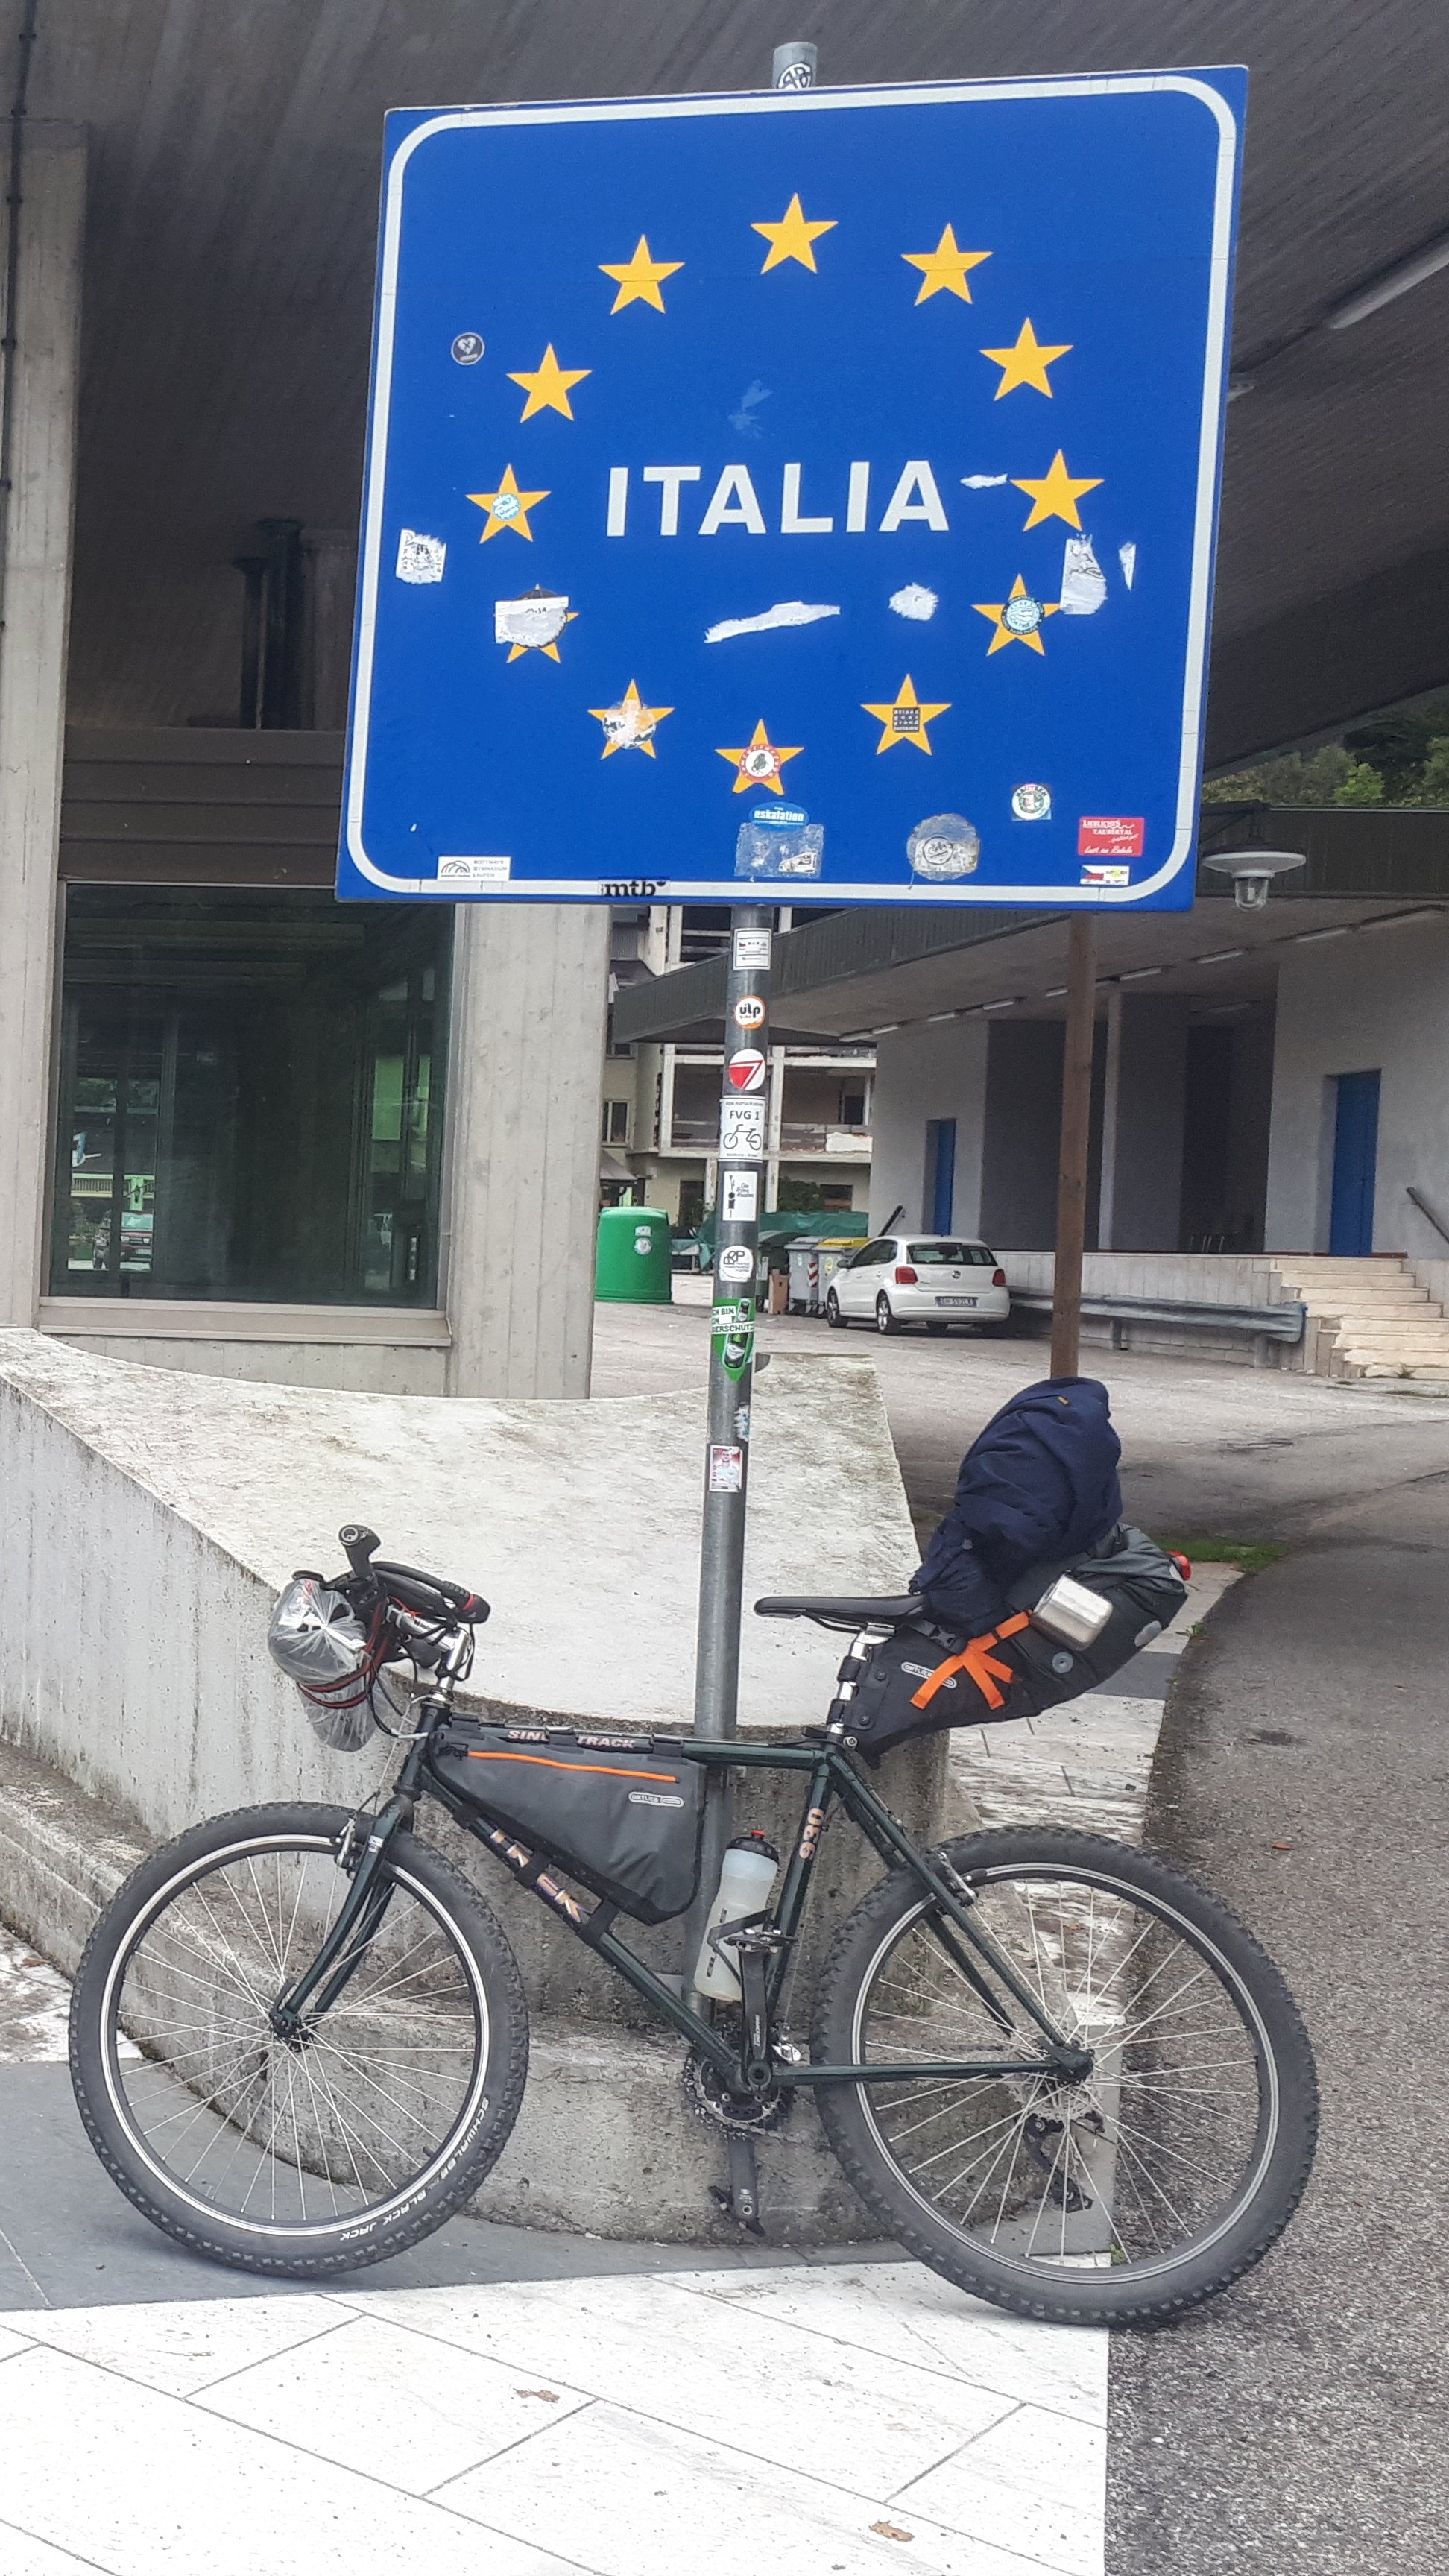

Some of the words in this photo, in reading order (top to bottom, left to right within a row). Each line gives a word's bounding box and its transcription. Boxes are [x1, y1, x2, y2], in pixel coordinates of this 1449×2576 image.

[607, 461, 949, 537] ITALIA
[754, 809, 804, 822] eskalation
[730, 1110, 752, 1120] FVG
[754, 1111, 760, 1121] 1
[441, 2097, 490, 2179] SCHWALBE
[382, 2189, 428, 2226] BLACK
[340, 2222, 378, 2241] JACK
